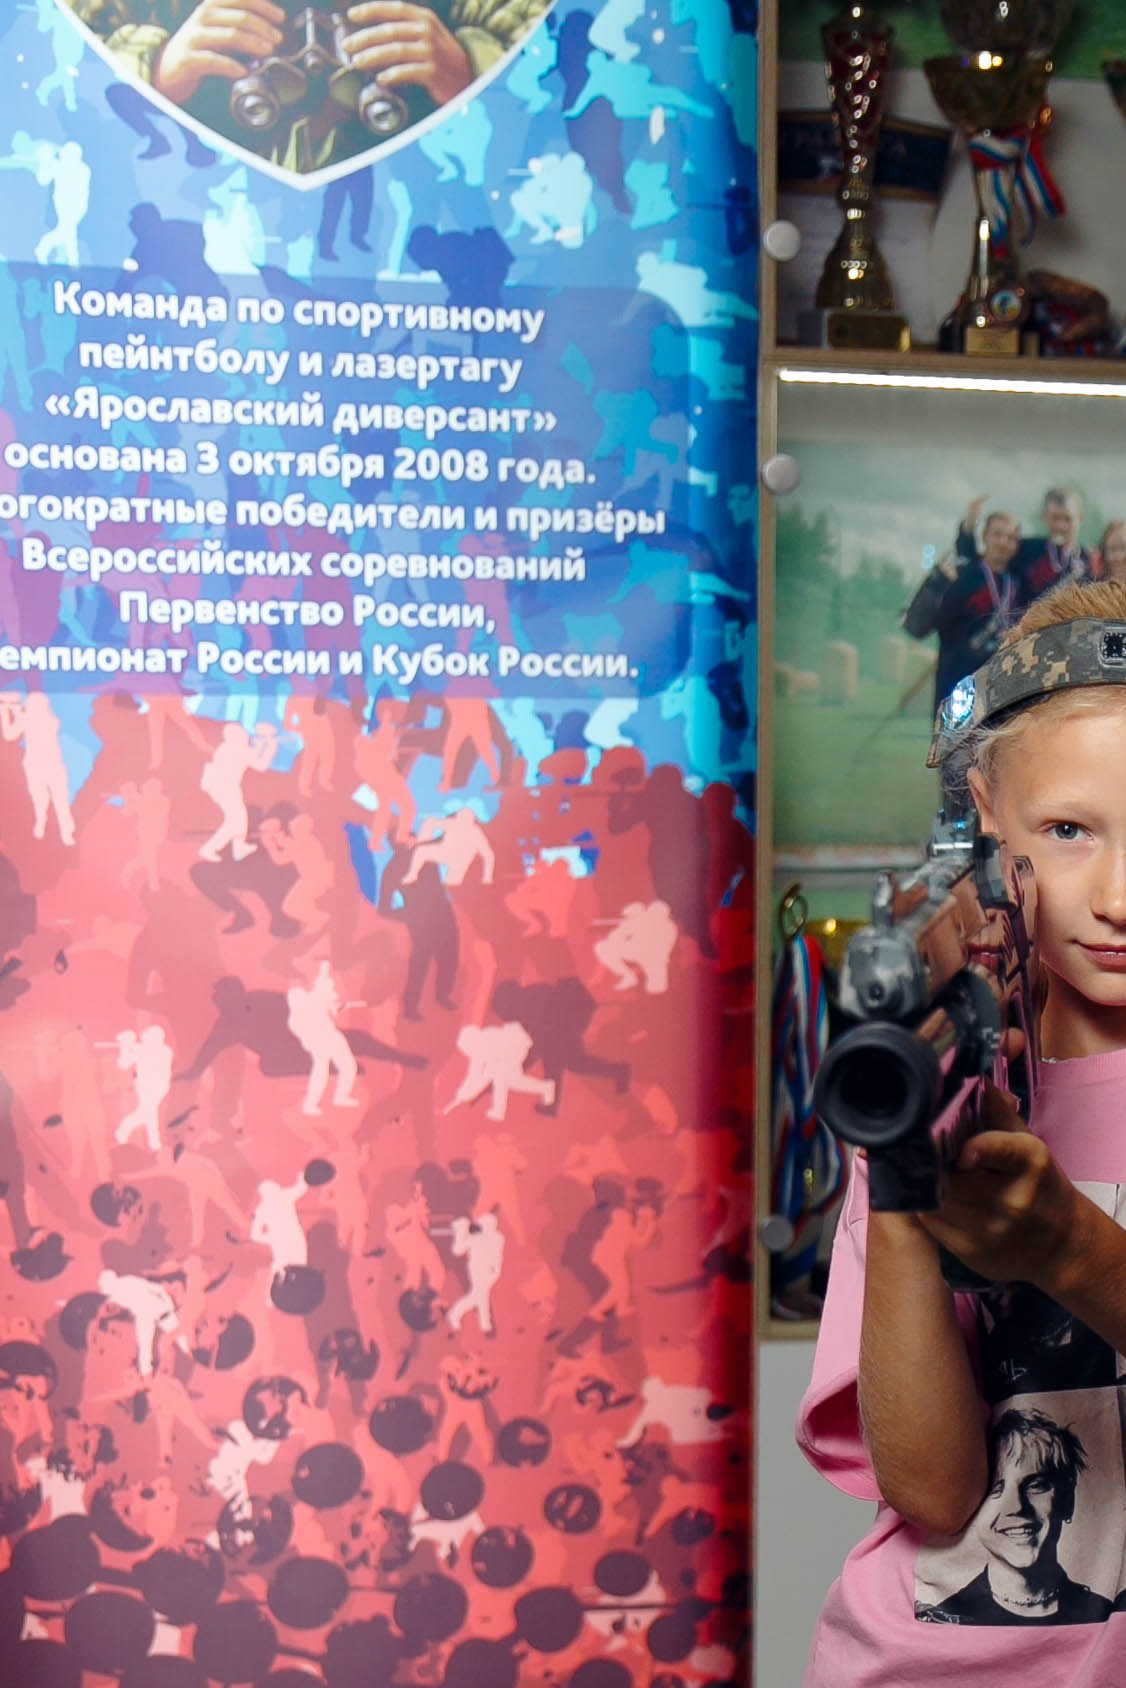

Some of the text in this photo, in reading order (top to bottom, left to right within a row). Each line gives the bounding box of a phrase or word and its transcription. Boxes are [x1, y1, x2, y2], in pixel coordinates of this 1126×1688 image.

[54, 280, 545, 343] Команда по спортивному
[79, 333, 523, 392] пейнтболу и лазертагу
[45, 385, 557, 440] «Ярославский диверсант»
[4, 441, 596, 491] основана 3 октября 2008 года.
[236, 493, 465, 534] победители
[475, 506, 498, 531] и
[507, 501, 666, 543] призёры
[22, 537, 586, 586] Всероссийских соревнований
[119, 590, 496, 635] Первенство России,
[197, 641, 331, 674] России
[338, 650, 363, 676] и
[372, 643, 489, 685] Кубок
[498, 645, 639, 678] России.
